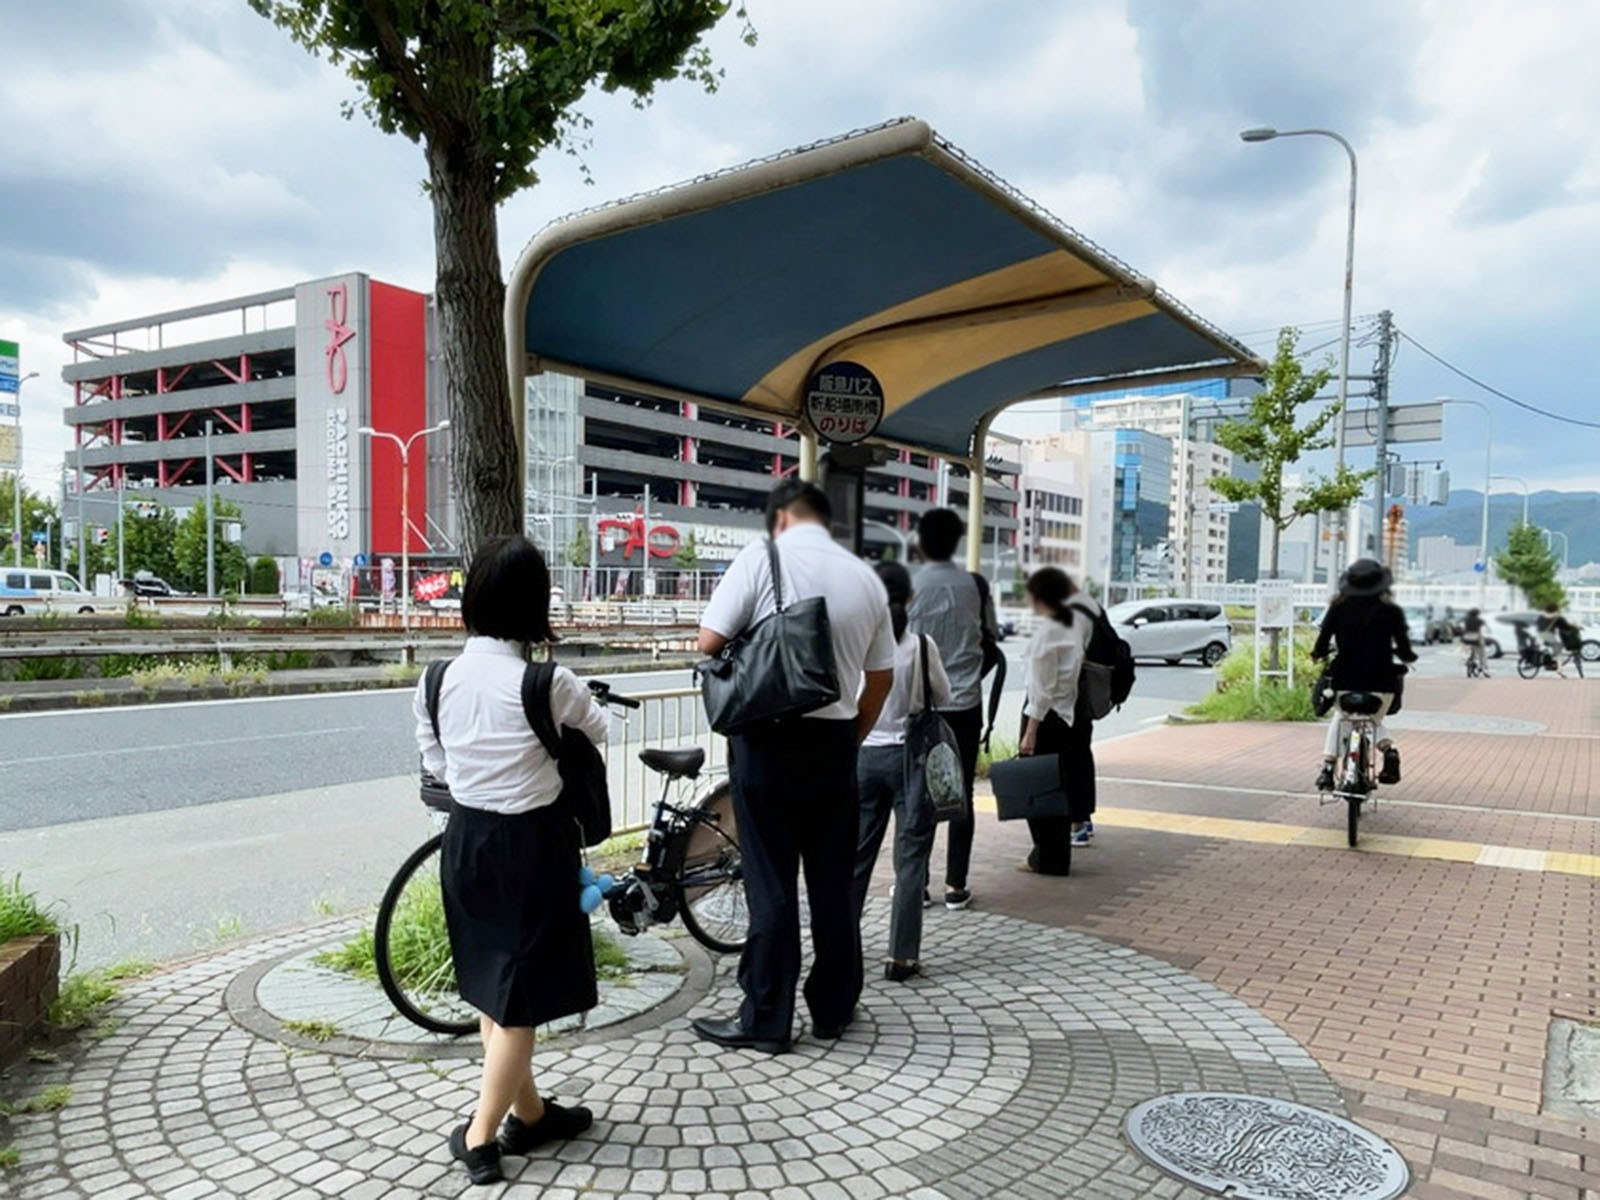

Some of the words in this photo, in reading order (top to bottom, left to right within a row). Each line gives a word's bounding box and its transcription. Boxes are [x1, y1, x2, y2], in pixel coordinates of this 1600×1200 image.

[820, 416, 868, 434] のりば
[335, 407, 349, 540] PACHINKO
